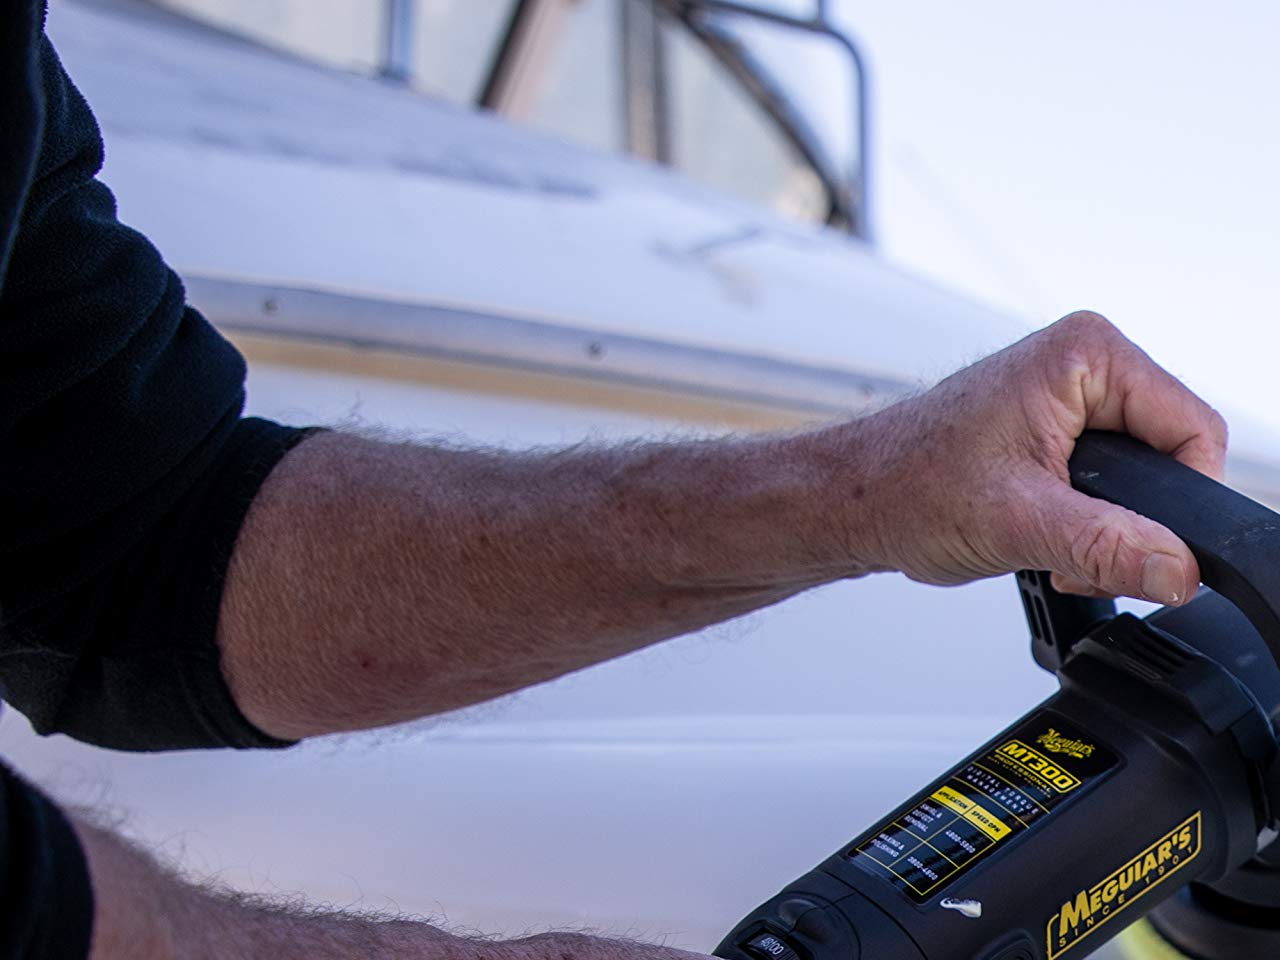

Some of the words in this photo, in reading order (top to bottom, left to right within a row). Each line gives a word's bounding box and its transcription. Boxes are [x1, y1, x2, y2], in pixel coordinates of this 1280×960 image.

[994, 754, 1051, 792] PROFESSIONAL
[1003, 743, 1073, 789] MT300
[937, 790, 968, 809] APPLICATION
[966, 765, 1001, 788] DIGITAL
[1004, 787, 1039, 814] TORQUE
[967, 774, 1025, 813] MANAGEMENT
[971, 810, 990, 826] SPEED
[1059, 825, 1191, 937] MEGUIAR'S
[1059, 894, 1126, 948] SINCE
[1144, 846, 1193, 884] 1901
